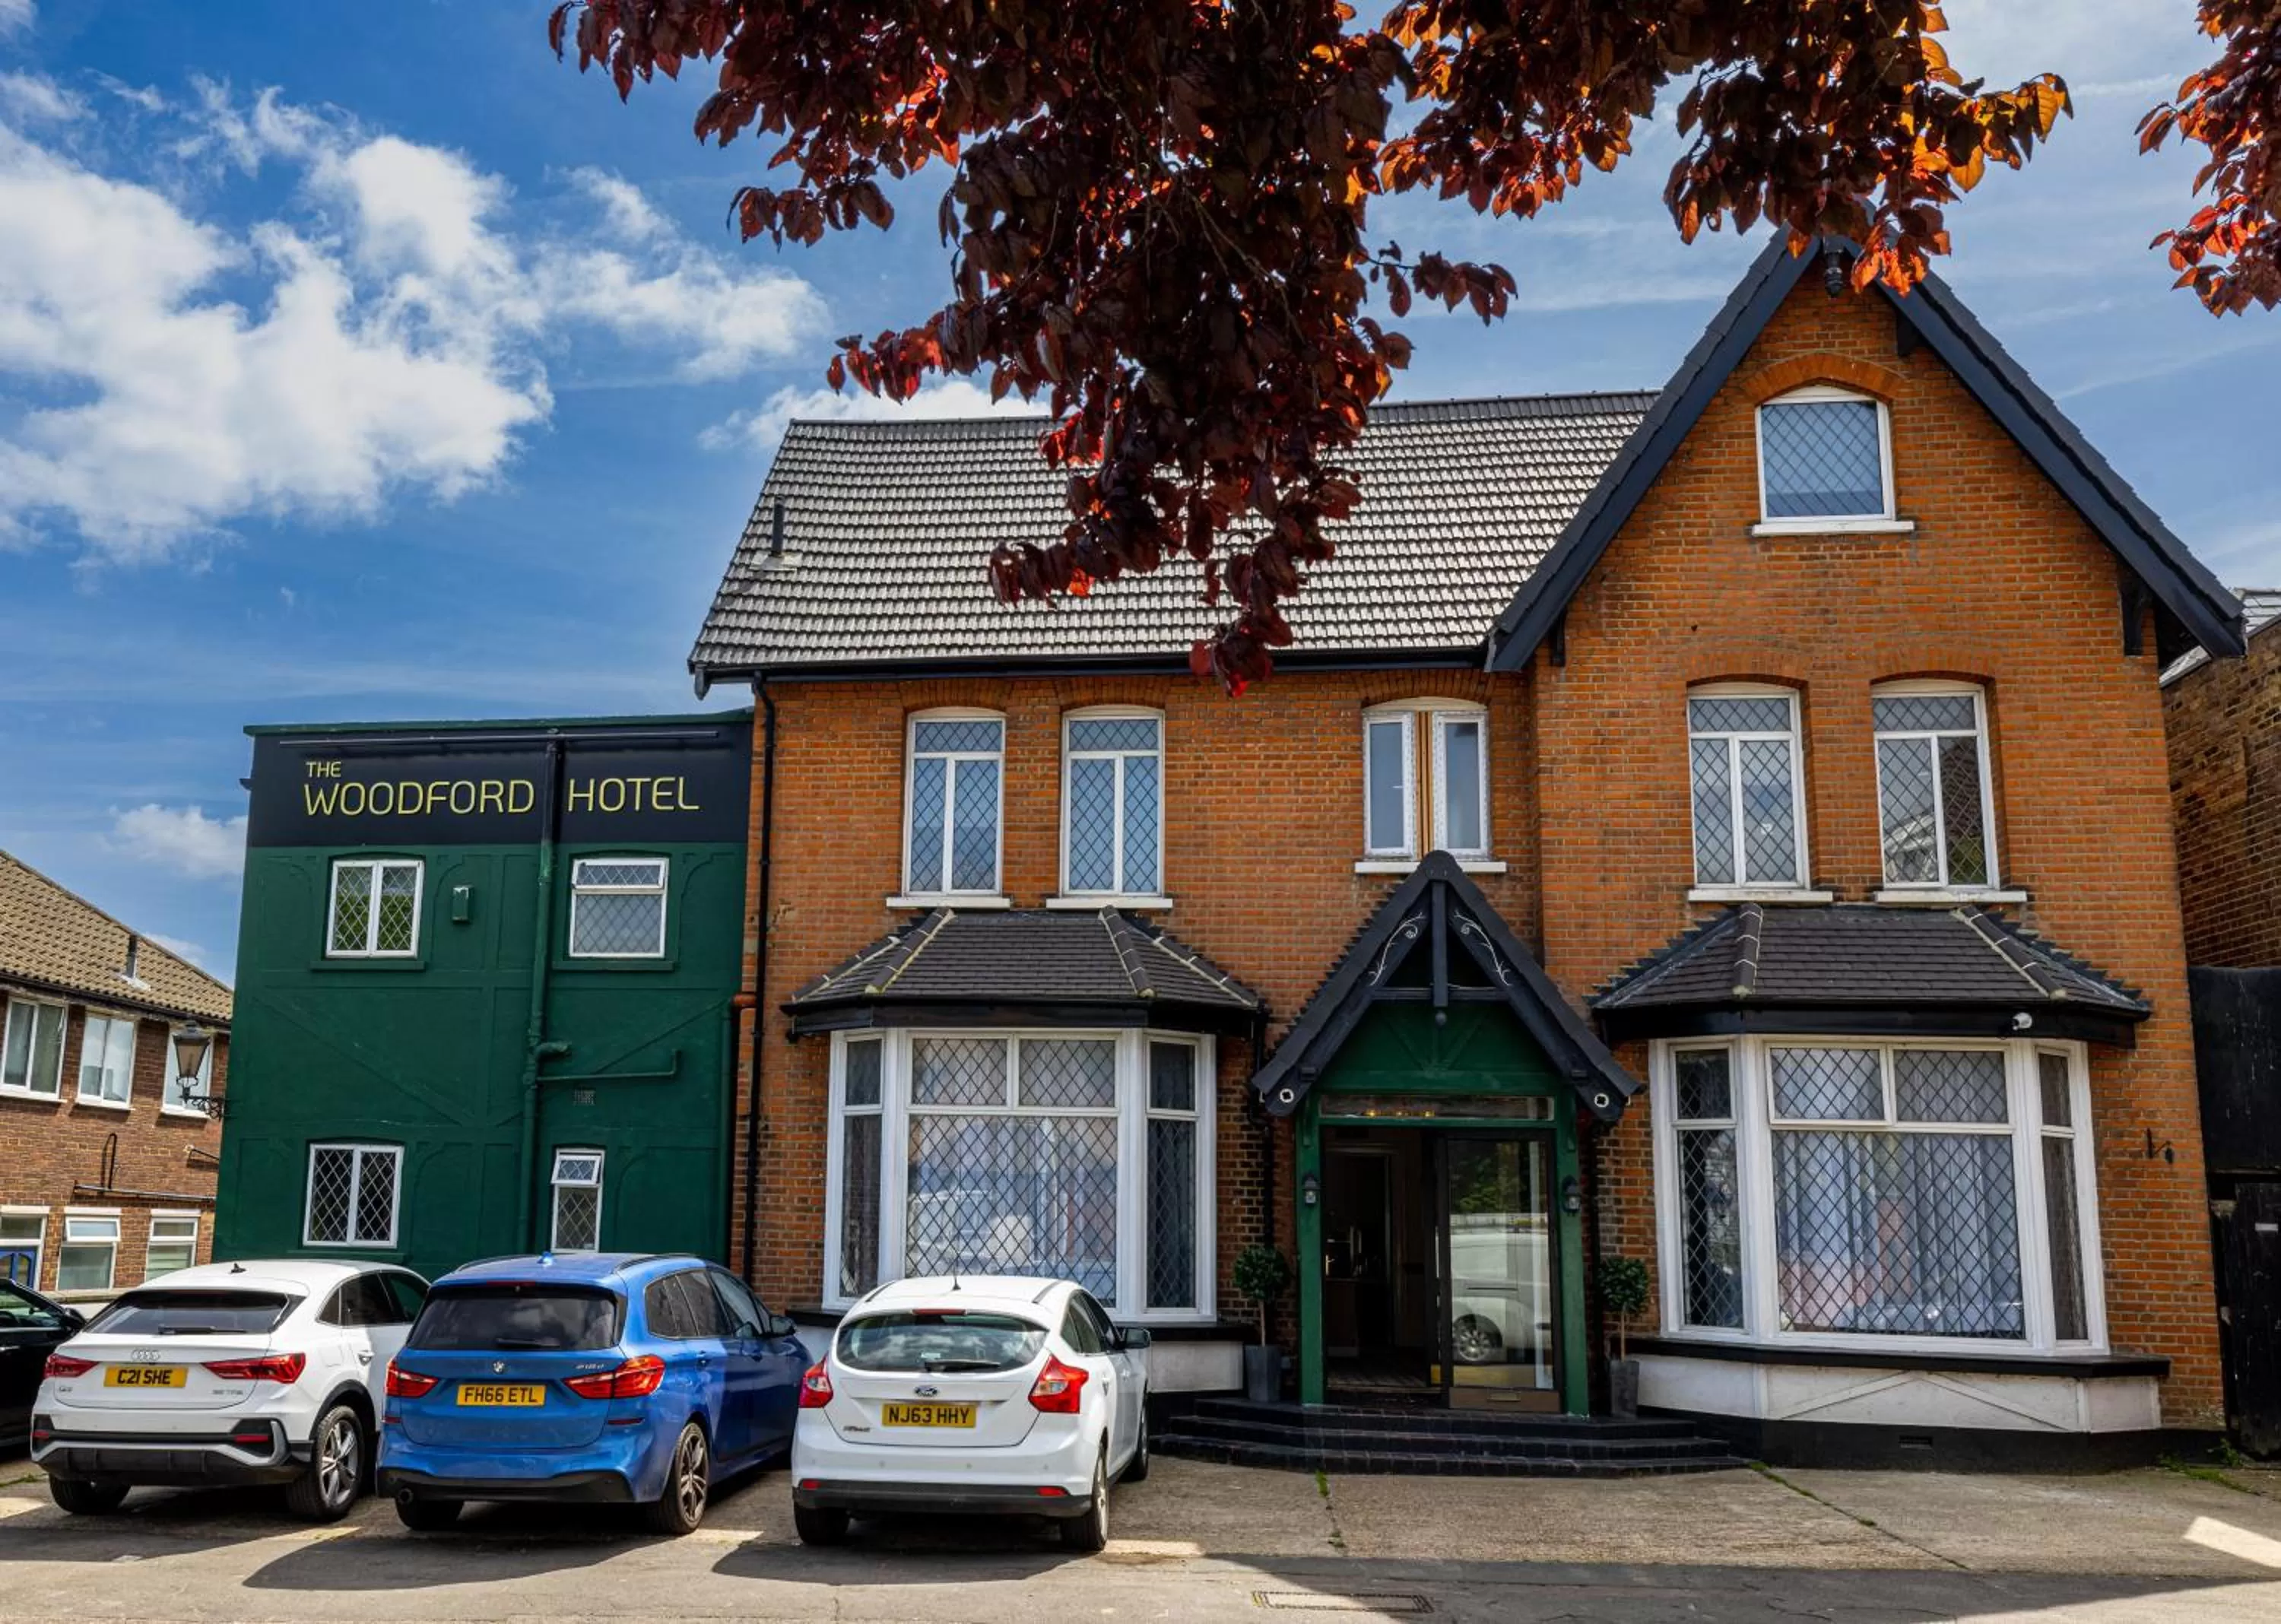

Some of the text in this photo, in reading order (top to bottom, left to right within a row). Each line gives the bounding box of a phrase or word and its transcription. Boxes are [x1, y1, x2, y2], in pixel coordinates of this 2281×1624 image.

[305, 761, 341, 778] THE
[304, 776, 700, 816] WOODFORD HOTEL
[117, 1369, 173, 1385] C21 SHE
[465, 1386, 538, 1403] FH66 ETL
[888, 1407, 970, 1424] NJ63 HHY
